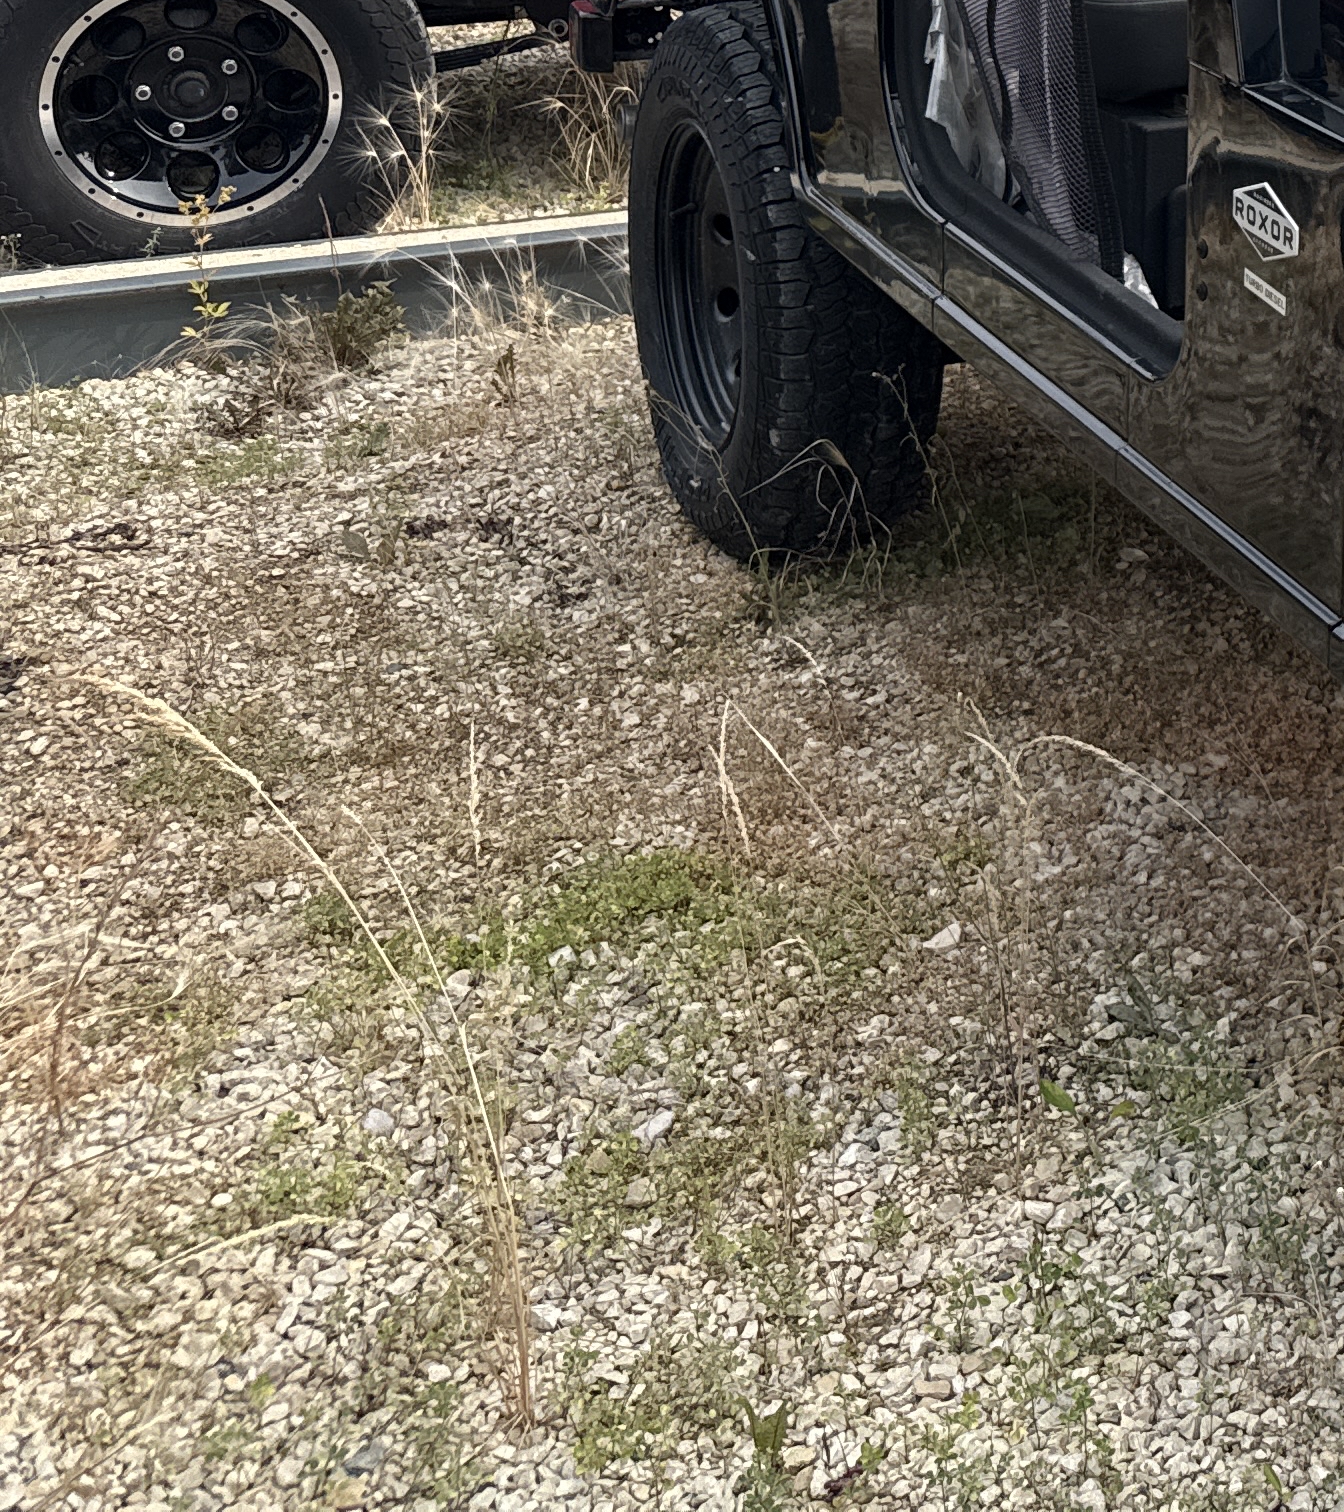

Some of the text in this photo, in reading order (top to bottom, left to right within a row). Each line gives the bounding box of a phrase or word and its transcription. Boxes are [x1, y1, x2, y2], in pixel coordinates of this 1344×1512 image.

[1234, 196, 1294, 251] ROXOR
[1246, 273, 1285, 310] TURBO DIESEL
